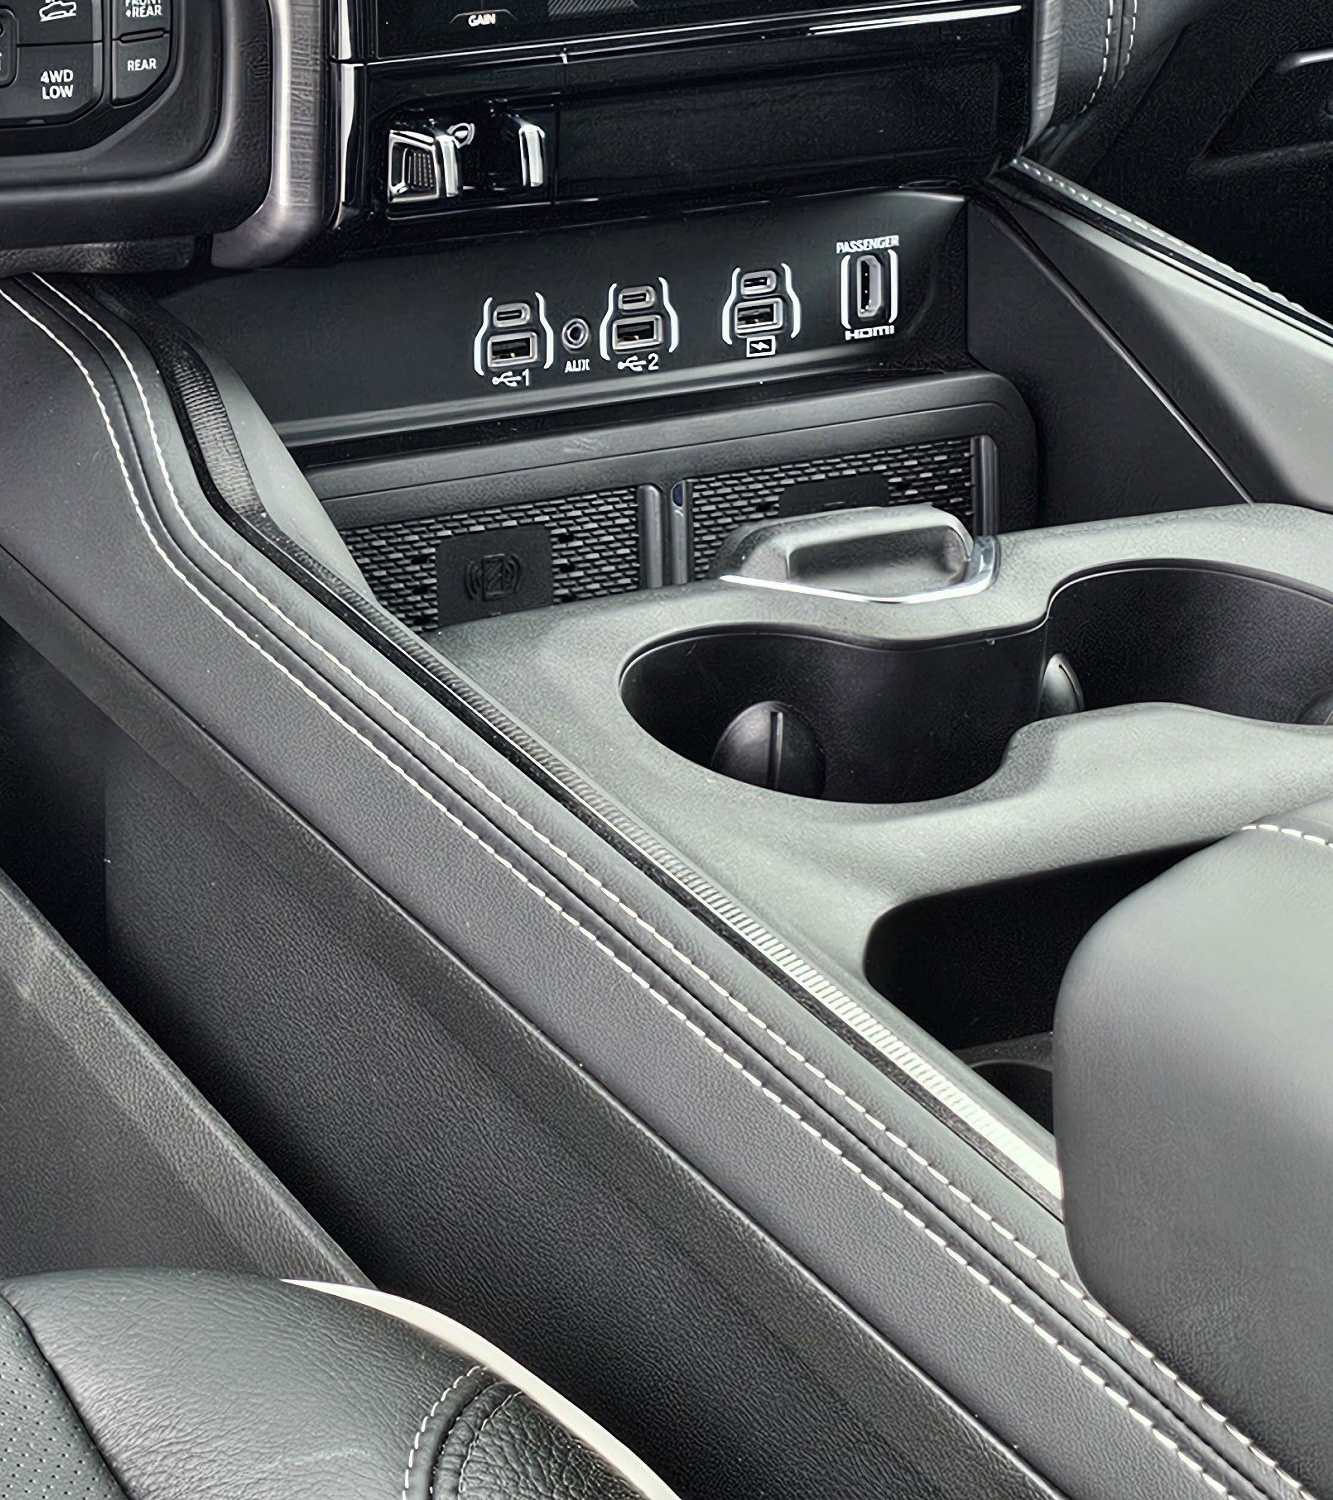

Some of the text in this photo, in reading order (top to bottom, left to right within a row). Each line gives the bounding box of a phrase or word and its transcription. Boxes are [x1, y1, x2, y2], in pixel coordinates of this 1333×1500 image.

[467, 12, 497, 28] GAIN
[127, 57, 158, 72] REAR
[40, 68, 75, 85] 4WD
[41, 83, 75, 101] LOW
[835, 234, 900, 254] PASSENGER
[844, 324, 896, 341] HDMI
[564, 358, 591, 373] AUX
[646, 352, 660, 372] 2
[521, 368, 531, 387] 1
